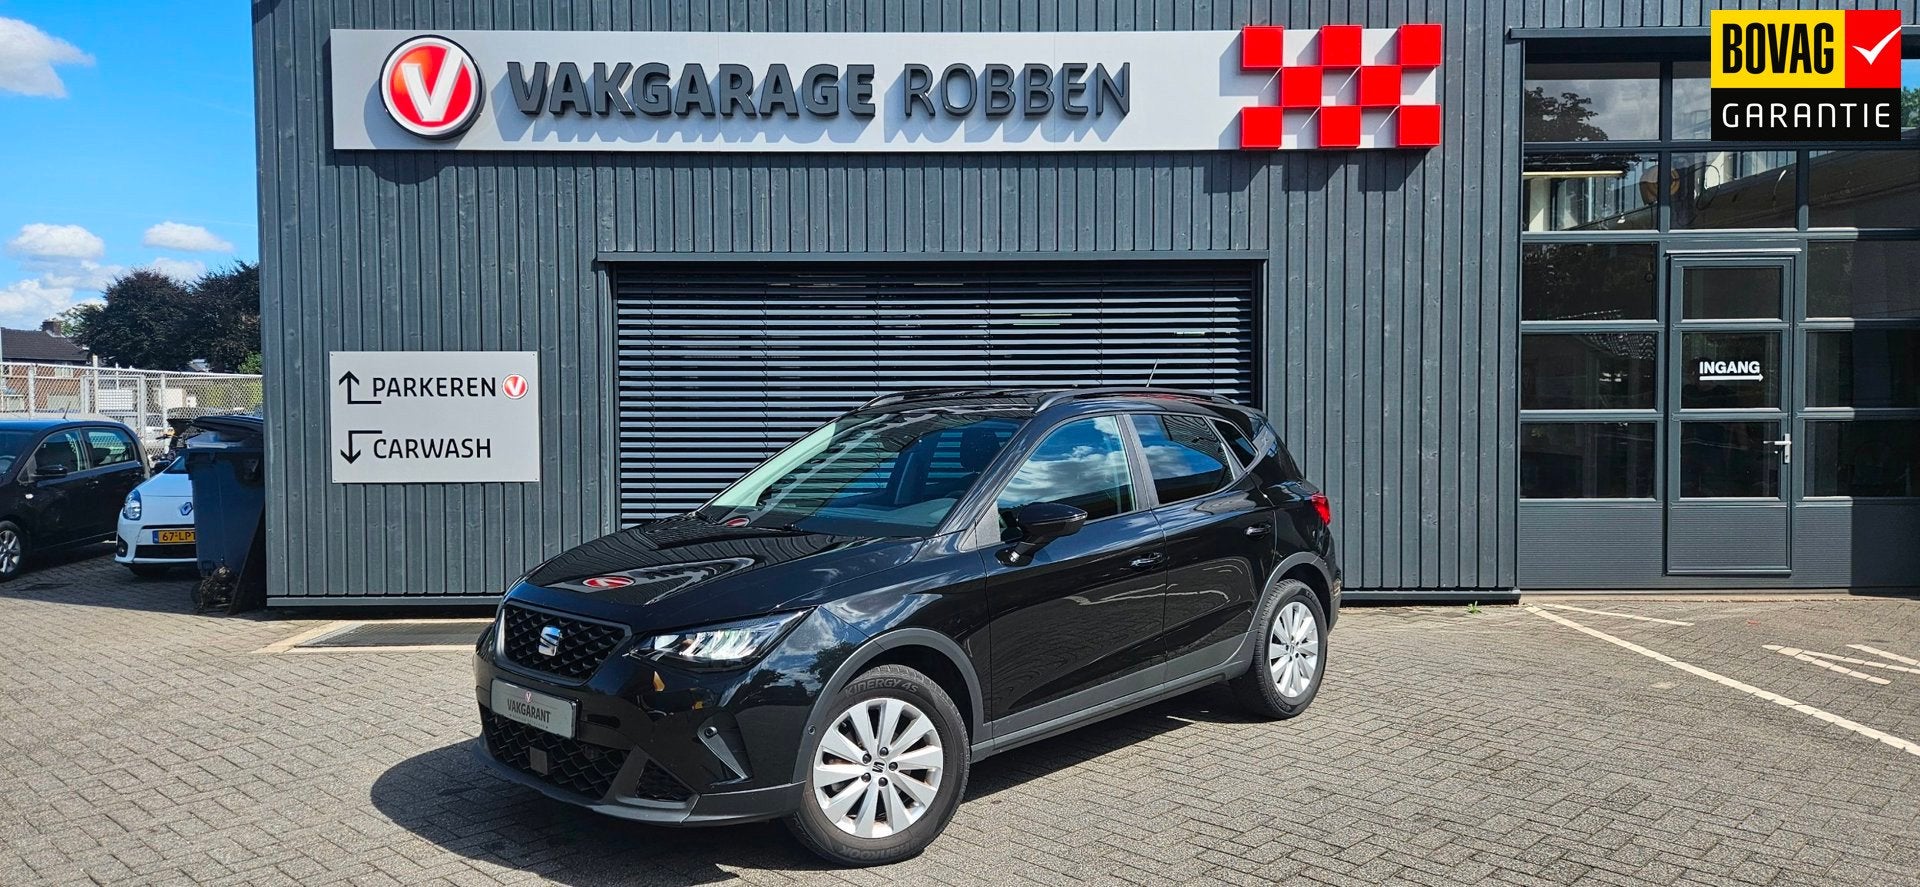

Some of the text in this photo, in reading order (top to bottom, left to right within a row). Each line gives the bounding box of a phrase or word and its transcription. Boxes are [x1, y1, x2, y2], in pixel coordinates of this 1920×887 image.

[401, 46, 1131, 122] V VAKGARAGE ROBBEN
[1699, 361, 1760, 374] INGANG
[372, 377, 496, 397] PARKEREN
[373, 438, 491, 459] CARWASH
[507, 699, 551, 723] VAKGARANT
